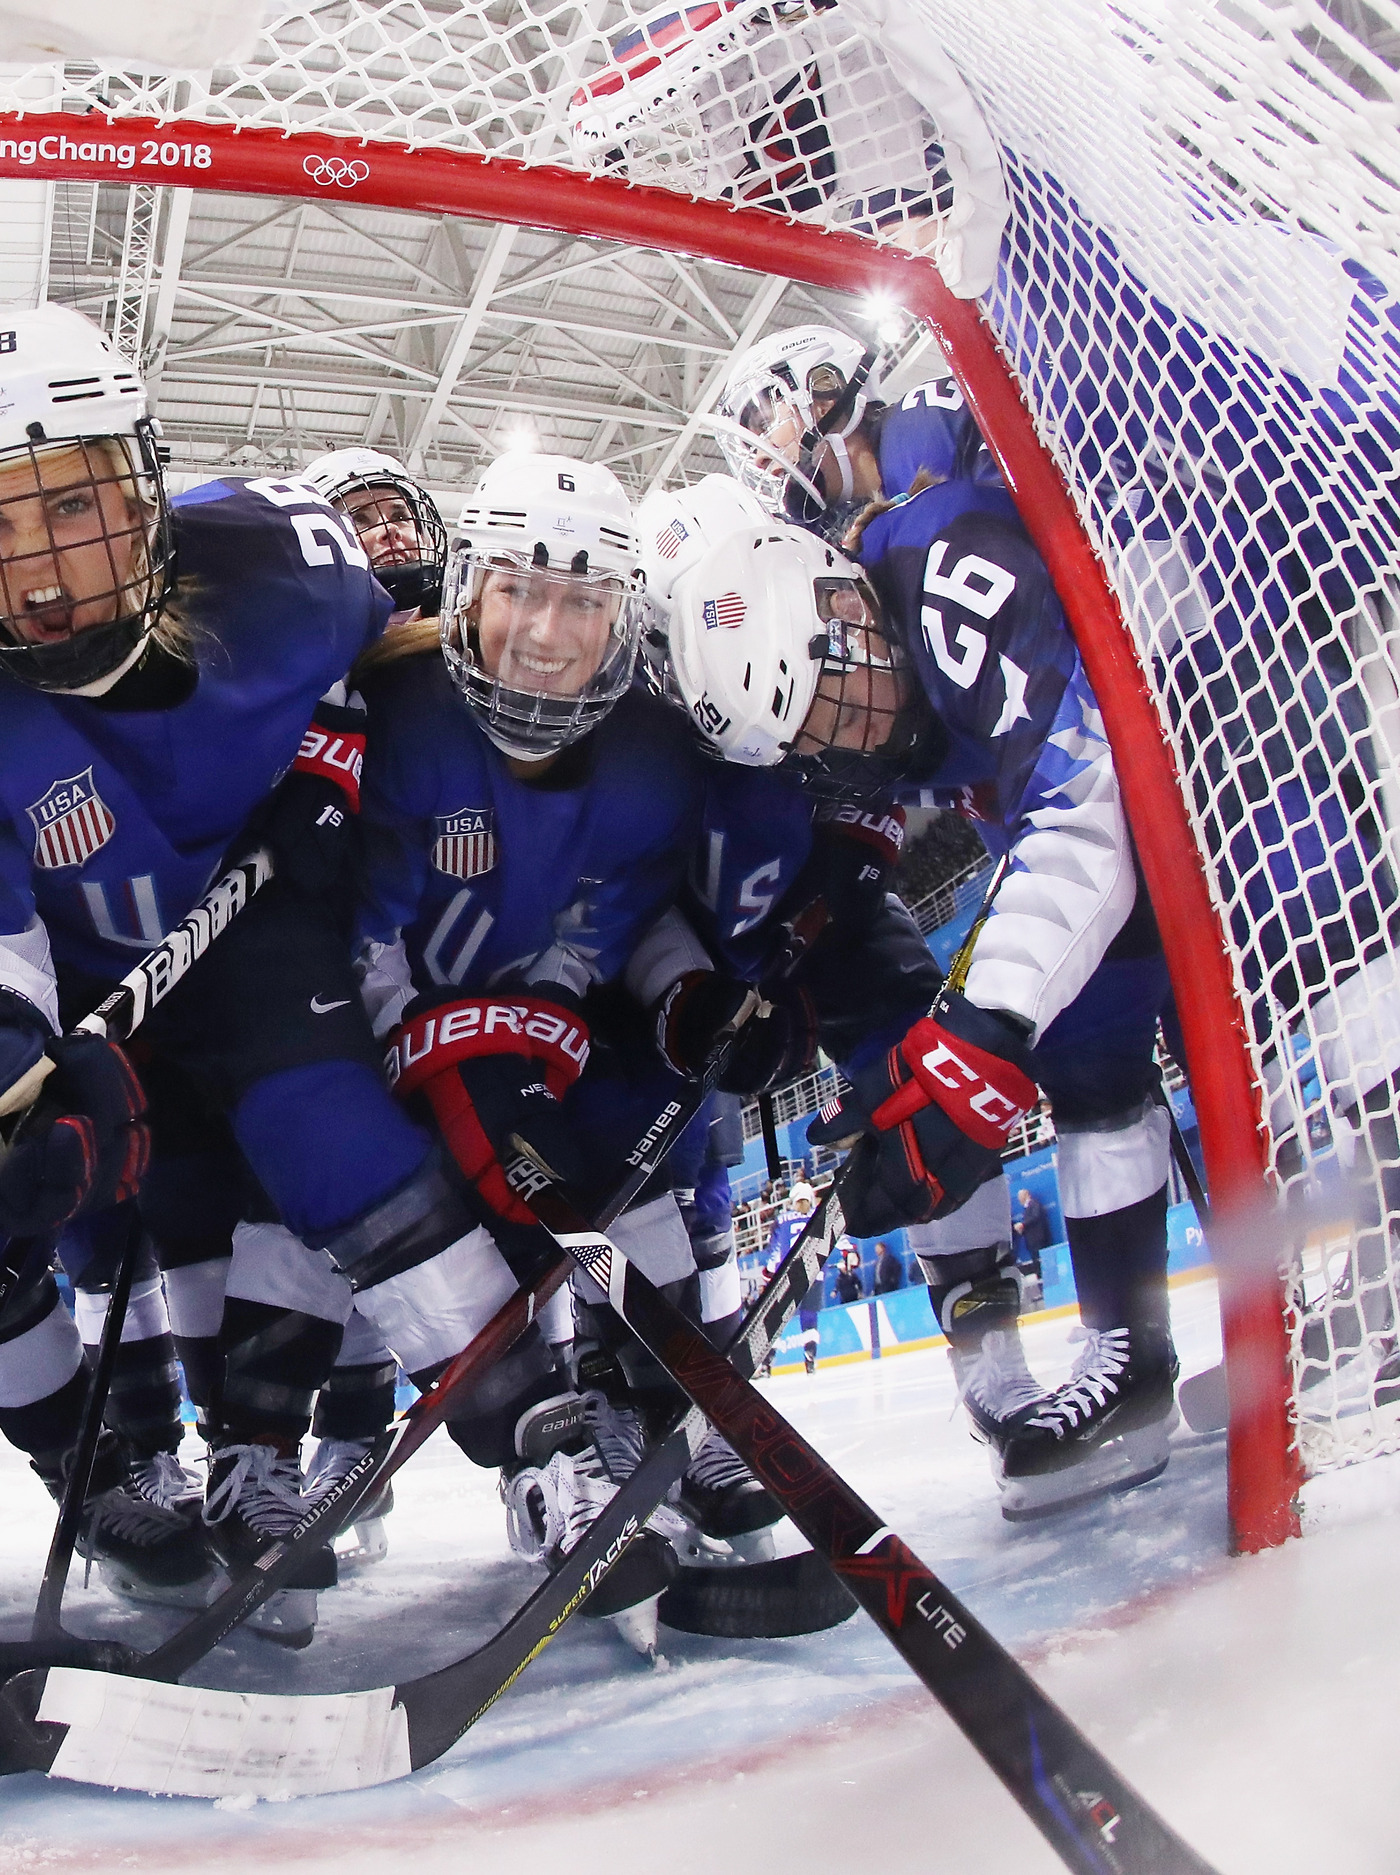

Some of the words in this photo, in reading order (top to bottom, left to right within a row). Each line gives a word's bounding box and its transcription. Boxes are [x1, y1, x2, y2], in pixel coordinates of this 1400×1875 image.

[141, 140, 212, 169] 2018
[557, 473, 575, 493] 6
[671, 519, 689, 541] USA
[704, 602, 717, 629] USA
[920, 539, 1017, 690] 26
[40, 783, 86, 823] USA
[445, 815, 485, 834] USA
[292, 1451, 375, 1541] SUPREME
[588, 1514, 640, 1591] TACKS
[548, 1584, 587, 1632] SUPER
[915, 1591, 967, 1650] LITE
